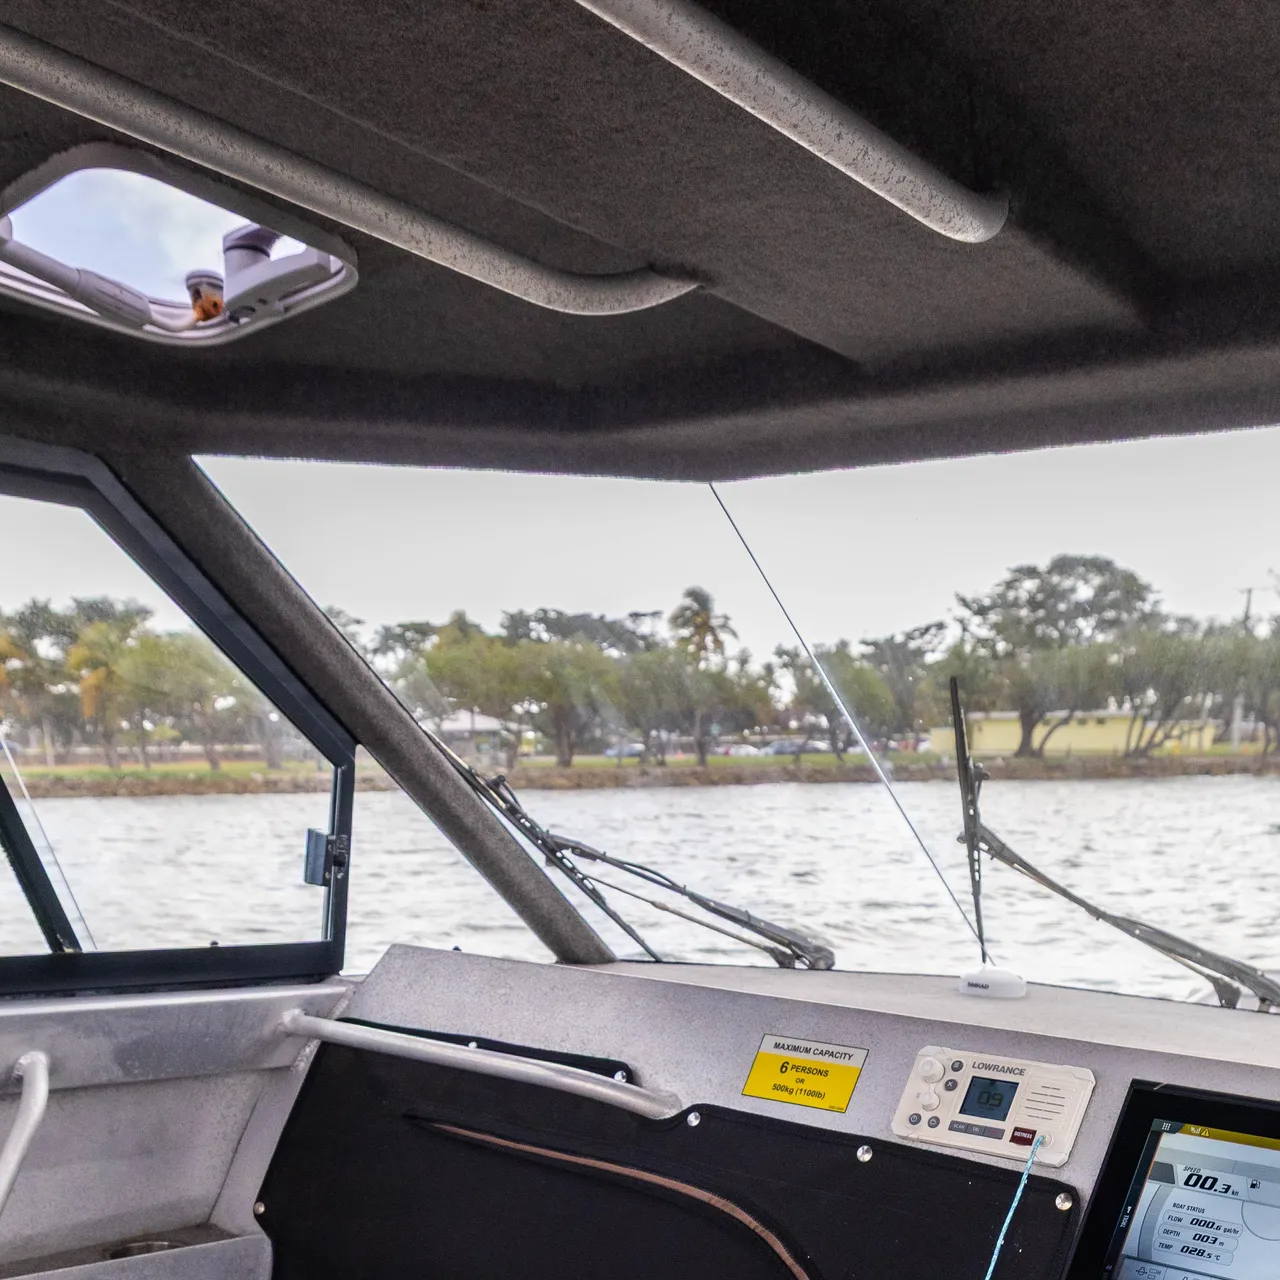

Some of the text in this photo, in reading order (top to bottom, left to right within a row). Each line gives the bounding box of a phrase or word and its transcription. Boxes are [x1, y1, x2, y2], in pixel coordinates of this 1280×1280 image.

[773, 1042, 854, 1061] MAXIMUM CAPACITY
[779, 1061, 829, 1077] 6 PERSONS
[972, 1061, 1027, 1077] LOWRANCE
[795, 1077, 805, 1085] OR
[772, 1084, 826, 1100] 500kg (1100lb)
[1172, 1202, 1205, 1214] BOAT STATUS
[1167, 1215, 1240, 1235] FLOW 000.6 gal/hr
[1162, 1228, 1180, 1237] DEPTH
[1192, 1233, 1218, 1245] 003
[1158, 1242, 1173, 1250] TEMP
[1180, 1245, 1212, 1259] 028.5
